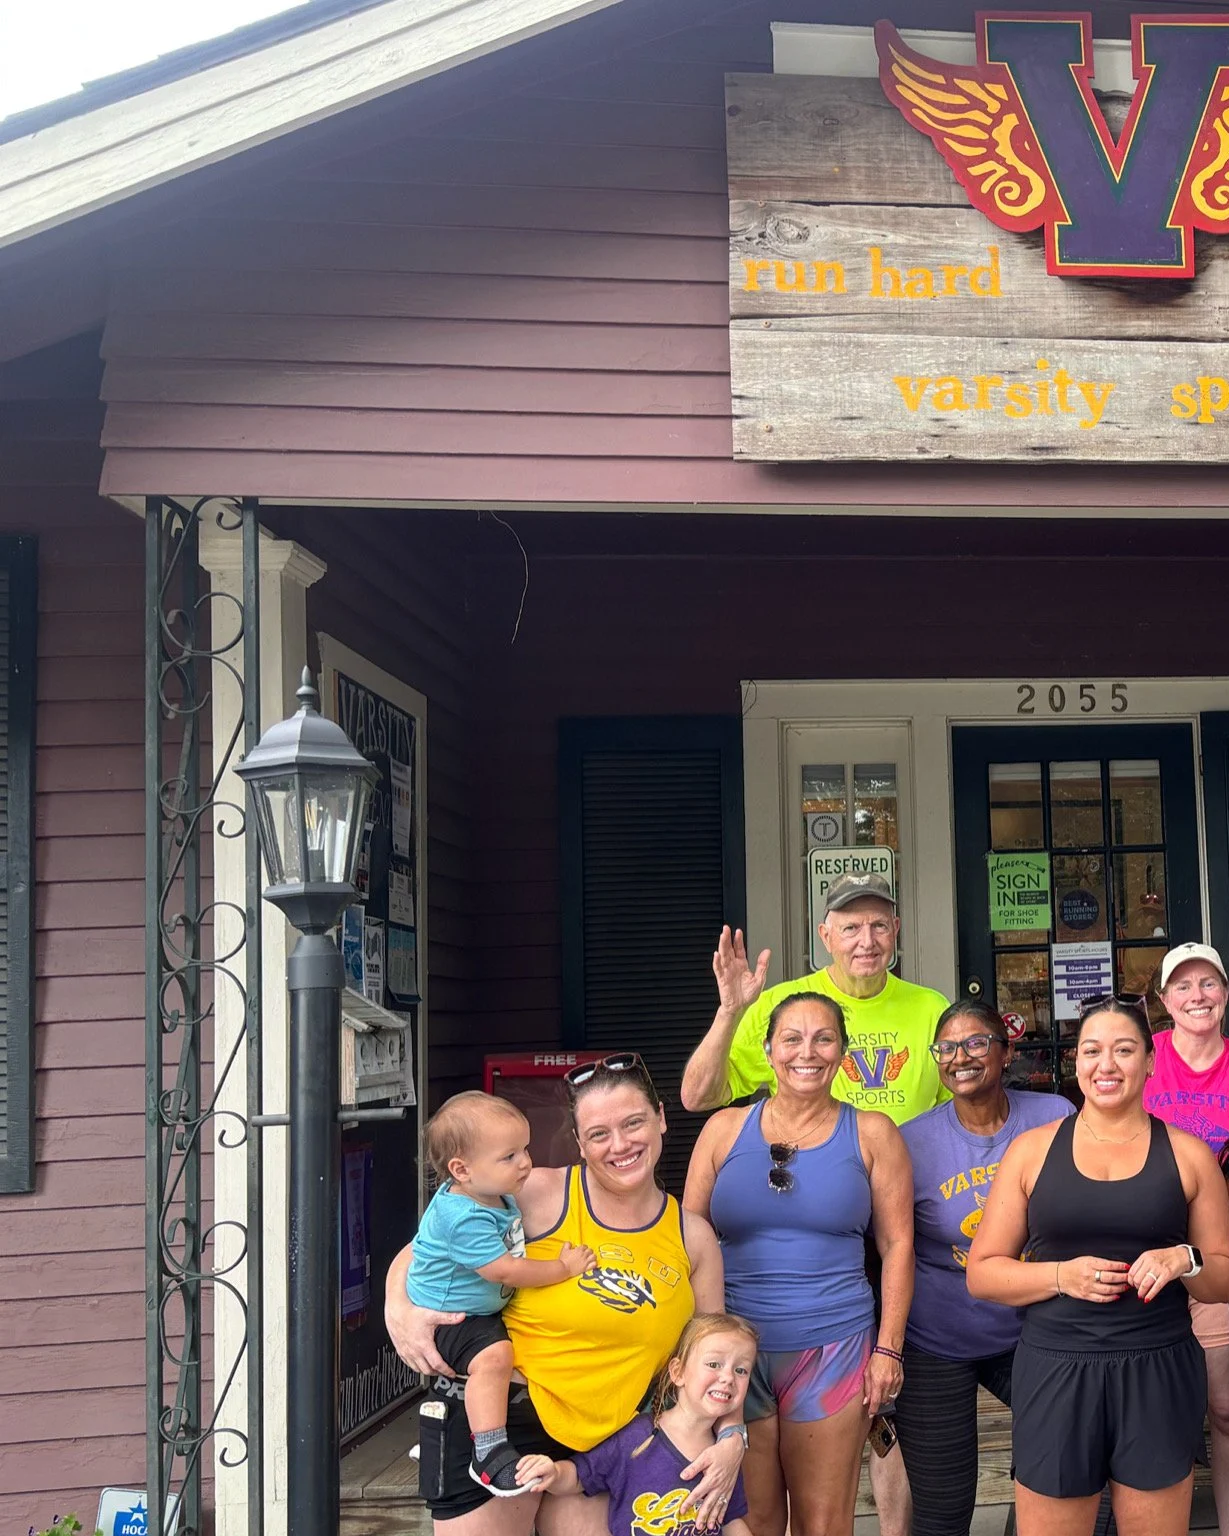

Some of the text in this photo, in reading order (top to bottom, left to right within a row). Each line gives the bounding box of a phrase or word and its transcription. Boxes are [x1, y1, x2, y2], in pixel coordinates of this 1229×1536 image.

[740, 245, 1003, 298] run hard
[893, 358, 1117, 429] varsity
[1016, 683, 1128, 714] 2055
[340, 679, 416, 760] VARSITY
[815, 857, 889, 875] RESERVED
[996, 873, 1040, 890] SIGN
[997, 891, 1017, 907] IN
[999, 908, 1039, 918] FOR SHOE
[1063, 906, 1098, 914] RUNNING
[1004, 917, 1034, 926] FITTING
[847, 1031, 898, 1047] ARSITY
[533, 1054, 577, 1066] FREE
[846, 1090, 906, 1105] SPORTS
[939, 1162, 1001, 1201] VARS
[339, 1376, 355, 1435] un
